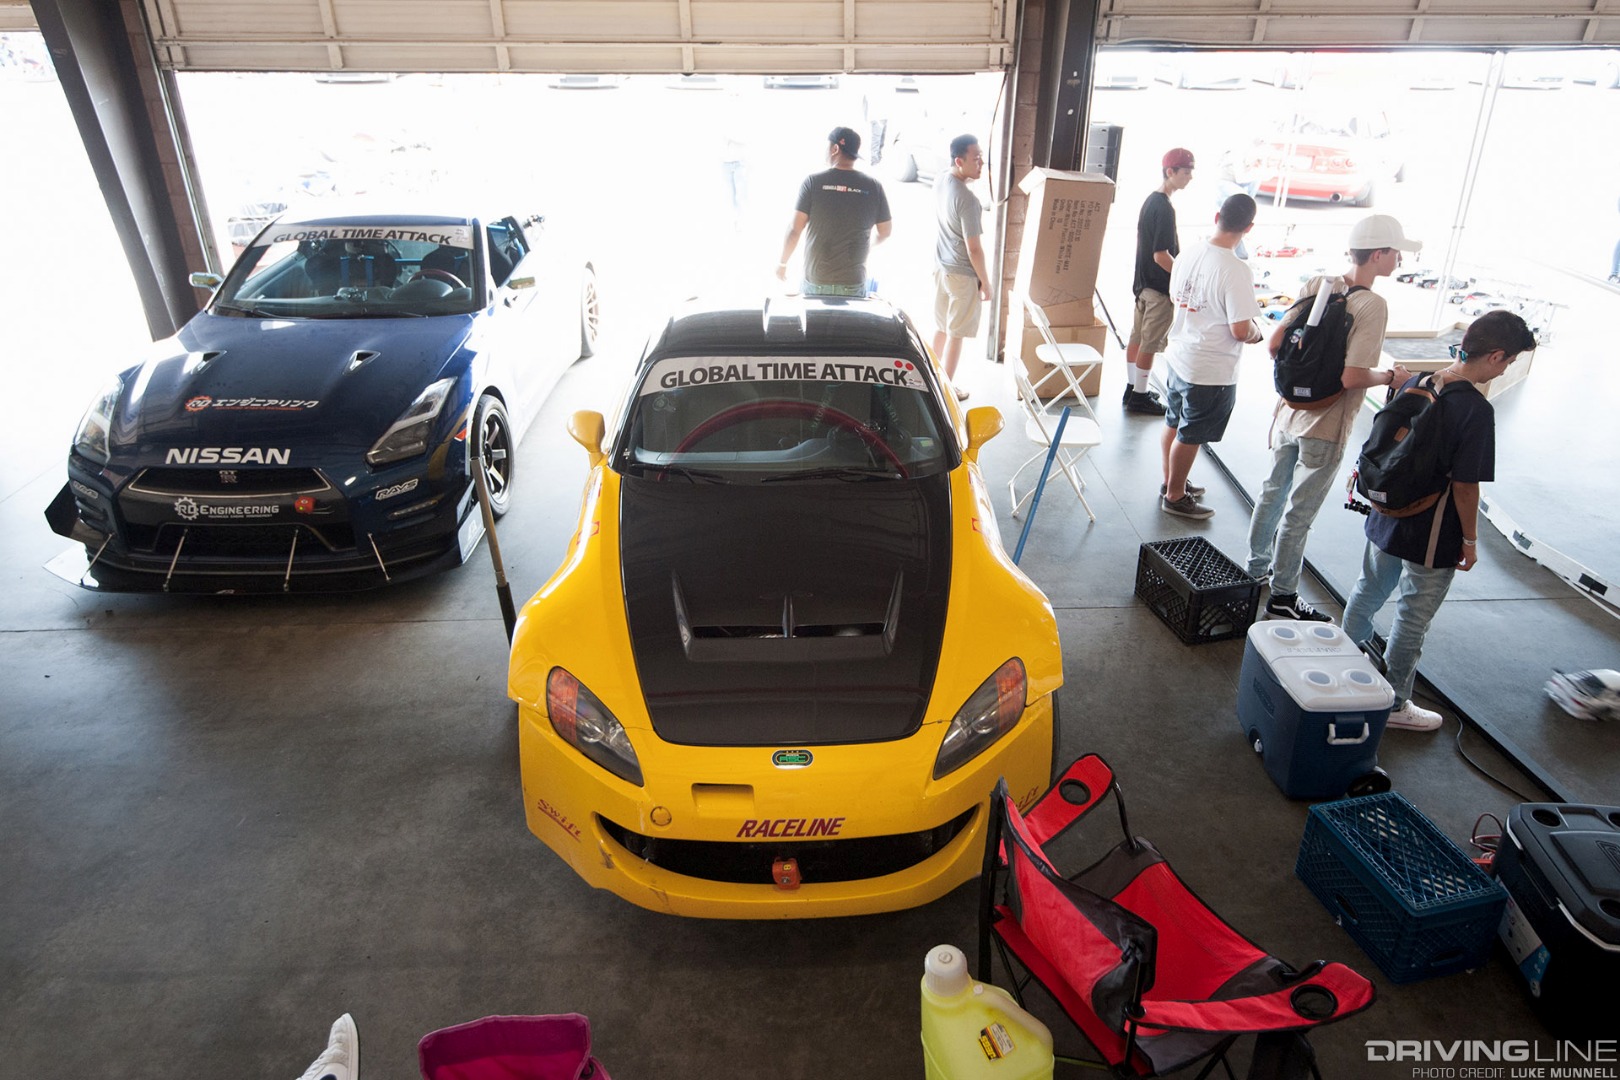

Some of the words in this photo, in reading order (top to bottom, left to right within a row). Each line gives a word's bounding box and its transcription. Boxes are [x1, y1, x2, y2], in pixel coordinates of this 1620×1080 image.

[273, 228, 341, 243] GLOBAL
[341, 228, 383, 240] TIME
[384, 229, 452, 245] ATTACK
[660, 365, 755, 389] GLOBAL
[757, 362, 817, 380] TIME
[820, 363, 908, 387] ATTACK
[166, 447, 291, 465] NISSAN
[375, 478, 419, 500] RAYS
[200, 505, 280, 515] ENGINEERING
[538, 799, 581, 839] Swift
[736, 817, 845, 837] RACELINE
